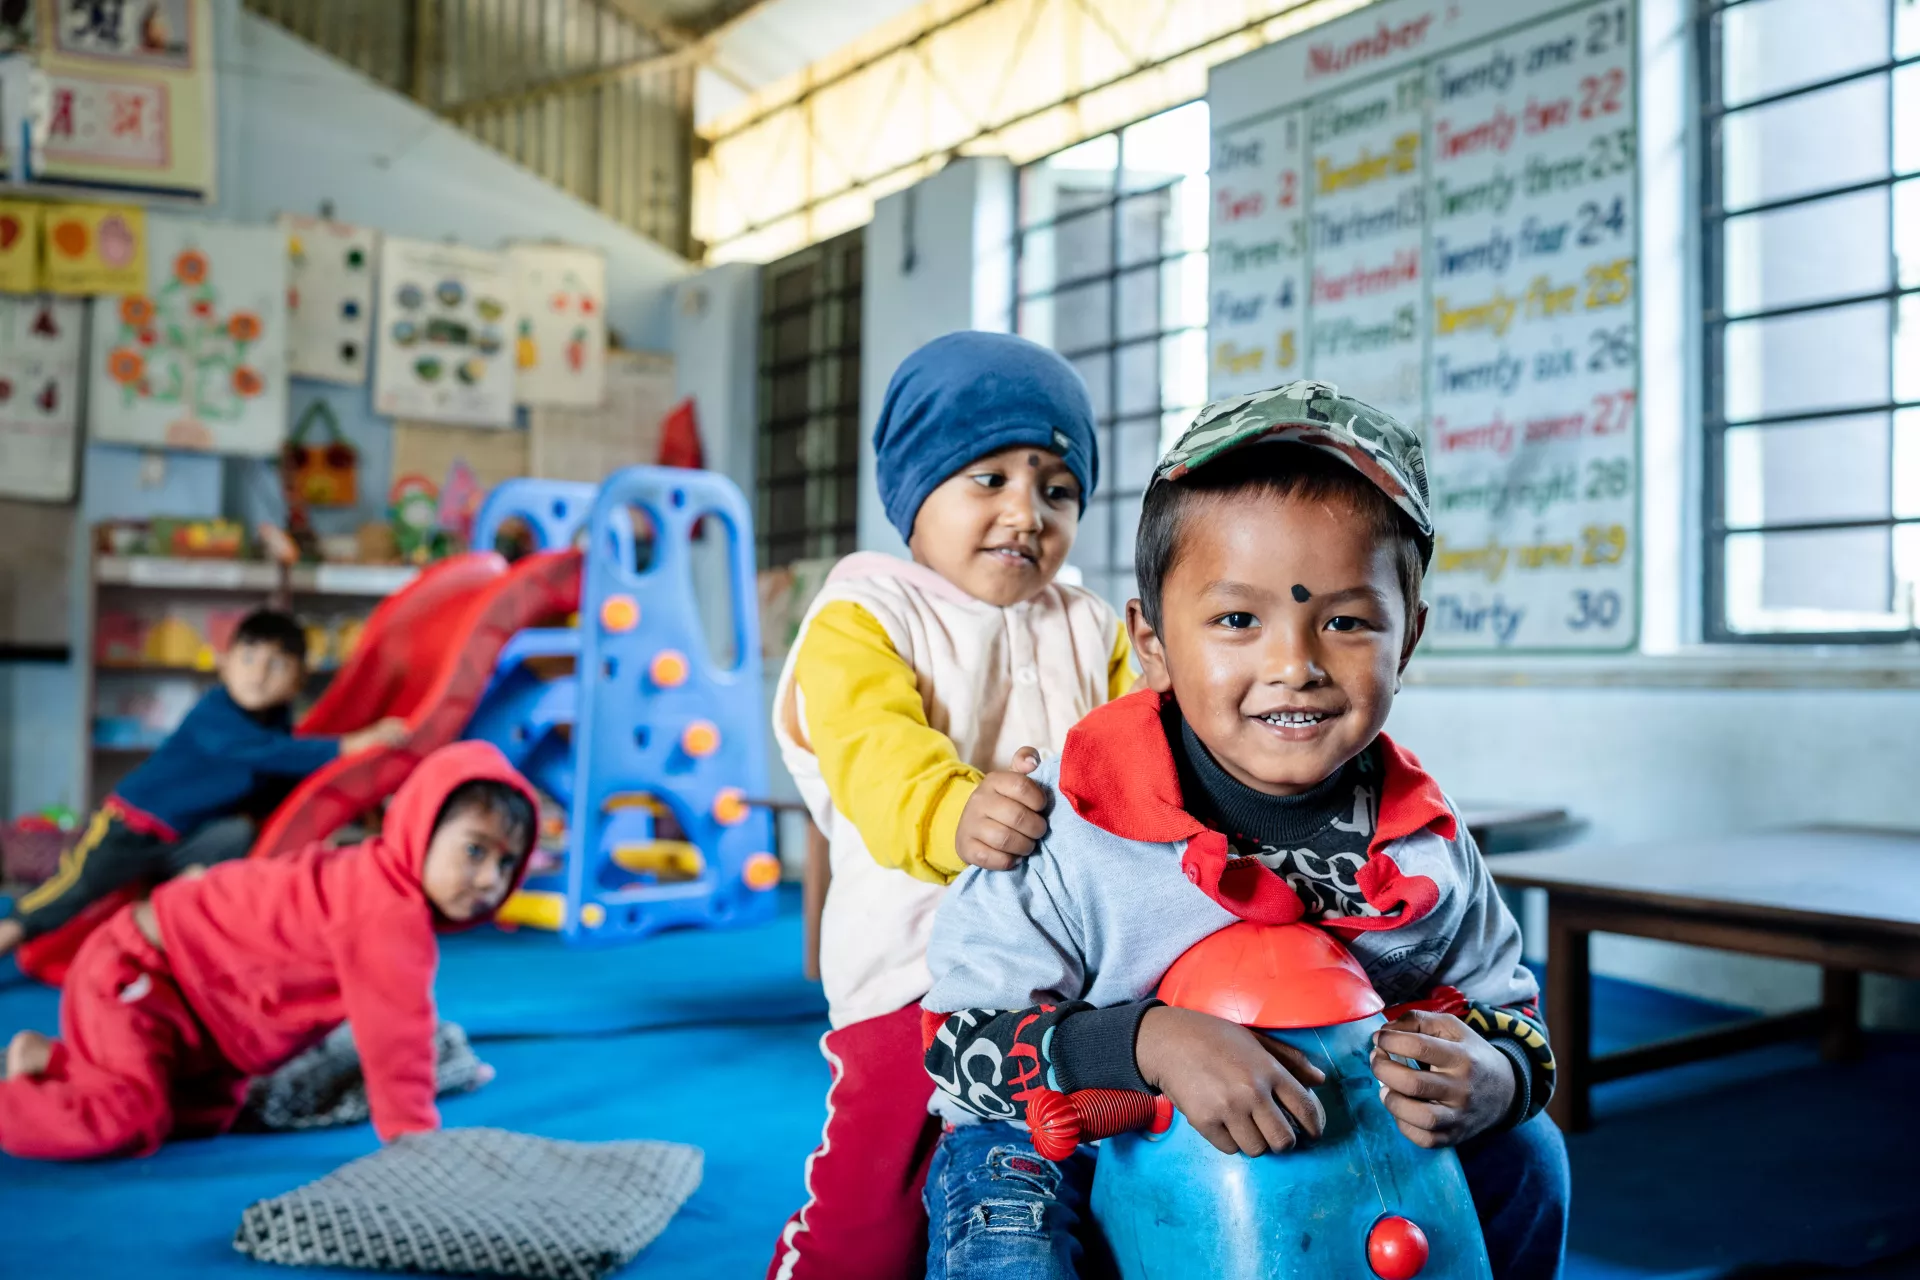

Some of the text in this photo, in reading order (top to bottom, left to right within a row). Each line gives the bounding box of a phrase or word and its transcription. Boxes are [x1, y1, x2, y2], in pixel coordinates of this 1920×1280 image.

[1304, 15, 1432, 80] Number
[1437, 8, 1626, 101] Twenty one 21
[1437, 68, 1625, 160] Twenty two 22
[1217, 170, 1297, 223] Two 2
[1437, 128, 1635, 215] Twenty three 23
[1437, 194, 1625, 277] Twenty four 24
[1276, 275, 1294, 308] 4
[1435, 257, 1635, 338] Twenty five 25
[1437, 346, 1523, 395] Twenty
[1532, 333, 1575, 381] six
[1588, 325, 1636, 374] 26
[1434, 410, 1513, 456] Twenty
[1592, 389, 1637, 438] 27
[1587, 457, 1629, 500] 28
[1436, 534, 1509, 583] Twenty
[1581, 523, 1627, 567] 29
[1434, 589, 1622, 646] Thirty 30
